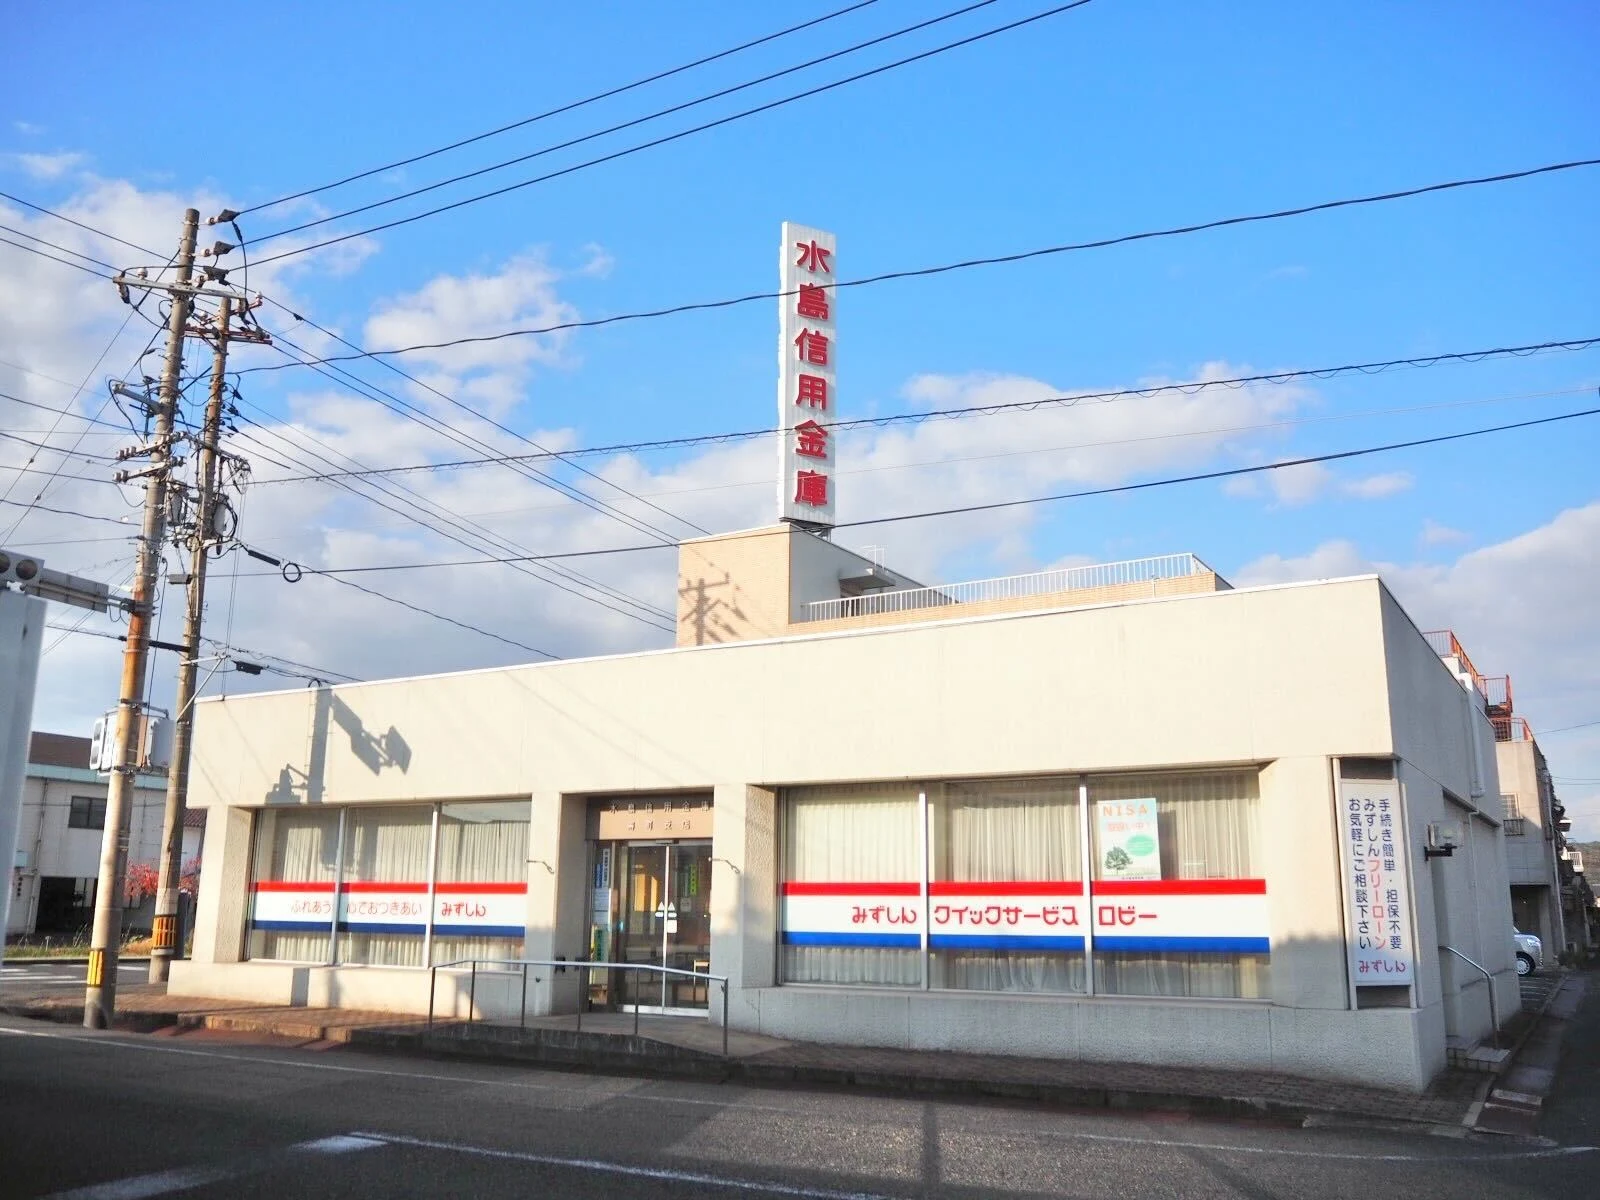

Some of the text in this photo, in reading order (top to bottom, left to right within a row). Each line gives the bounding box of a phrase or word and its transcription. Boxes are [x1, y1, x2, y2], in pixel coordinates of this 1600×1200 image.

[794, 239, 831, 507] 水島信用金庫
[1102, 803, 1148, 817] NISA
[1348, 798, 1372, 949] お気軽にご相談下さい
[440, 901, 487, 918] みずしん
[851, 905, 1158, 927] みずしん クイックサービス ロビー
[1357, 959, 1407, 974] みずしん
